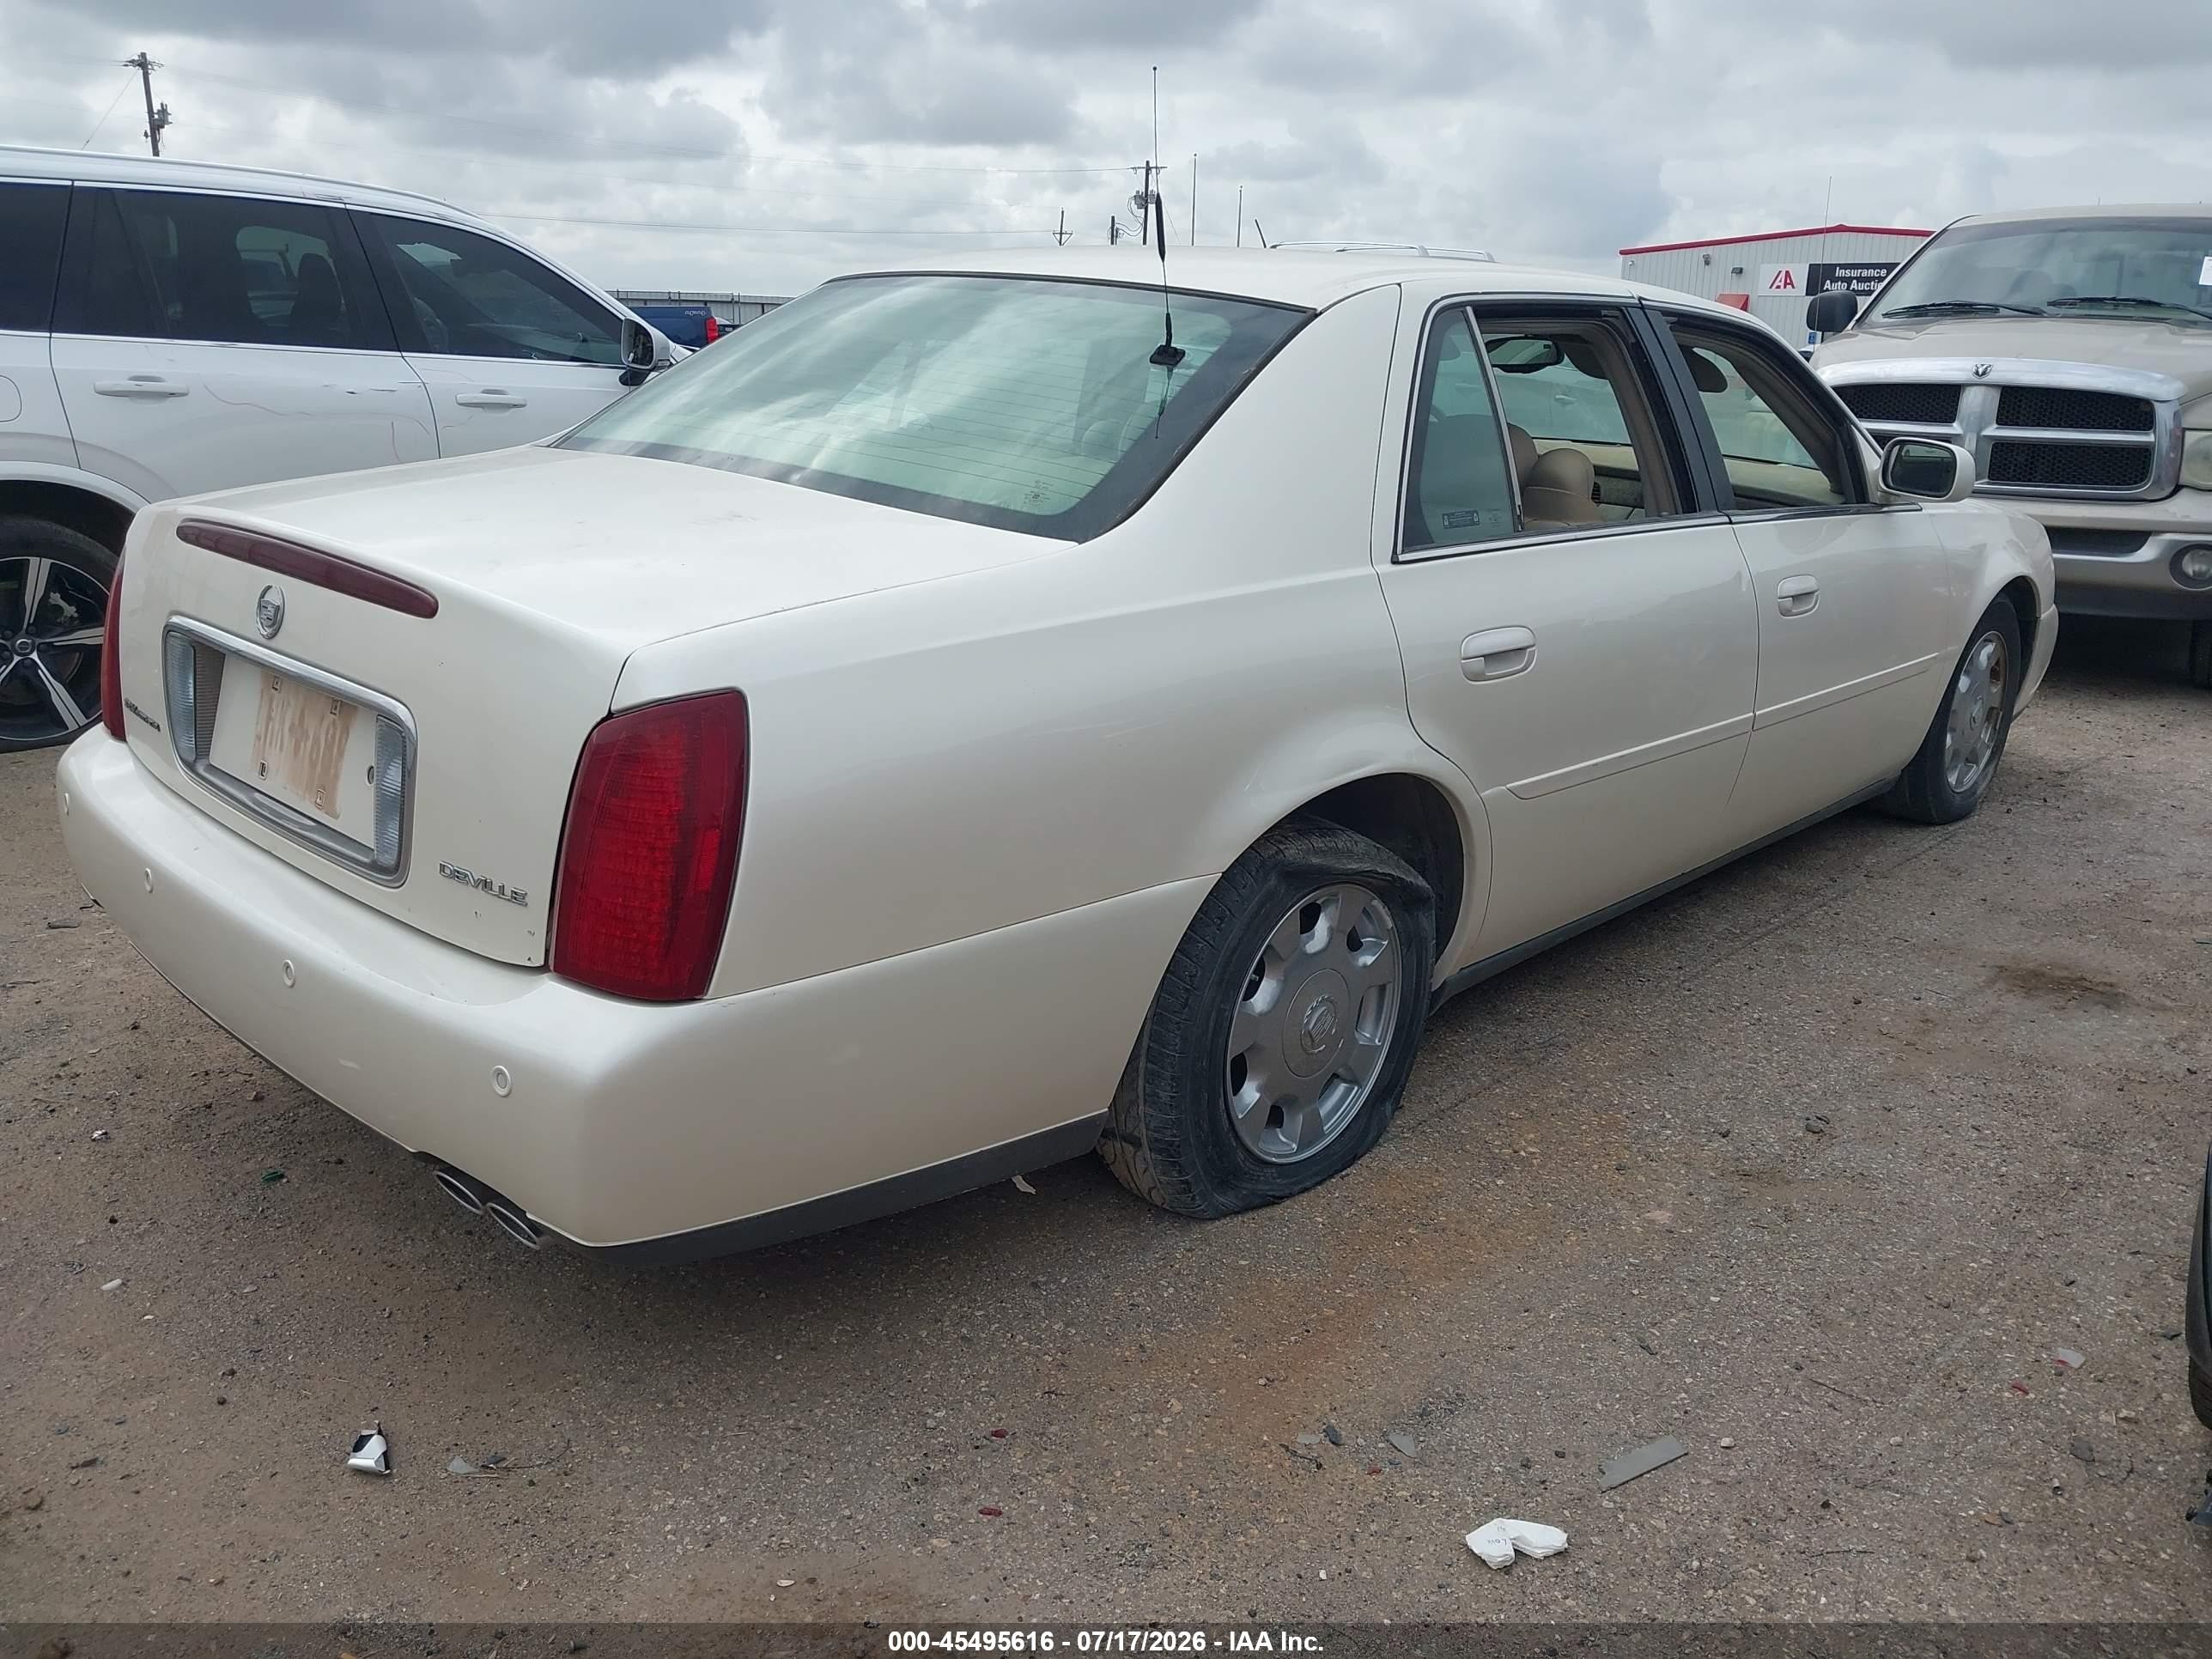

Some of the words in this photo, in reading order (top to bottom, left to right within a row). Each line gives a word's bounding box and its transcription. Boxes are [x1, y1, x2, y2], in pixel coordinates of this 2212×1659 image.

[1835, 266, 1887, 277] Insurance
[1823, 280, 1848, 290] Auto
[439, 860, 528, 907] DEVILLE
